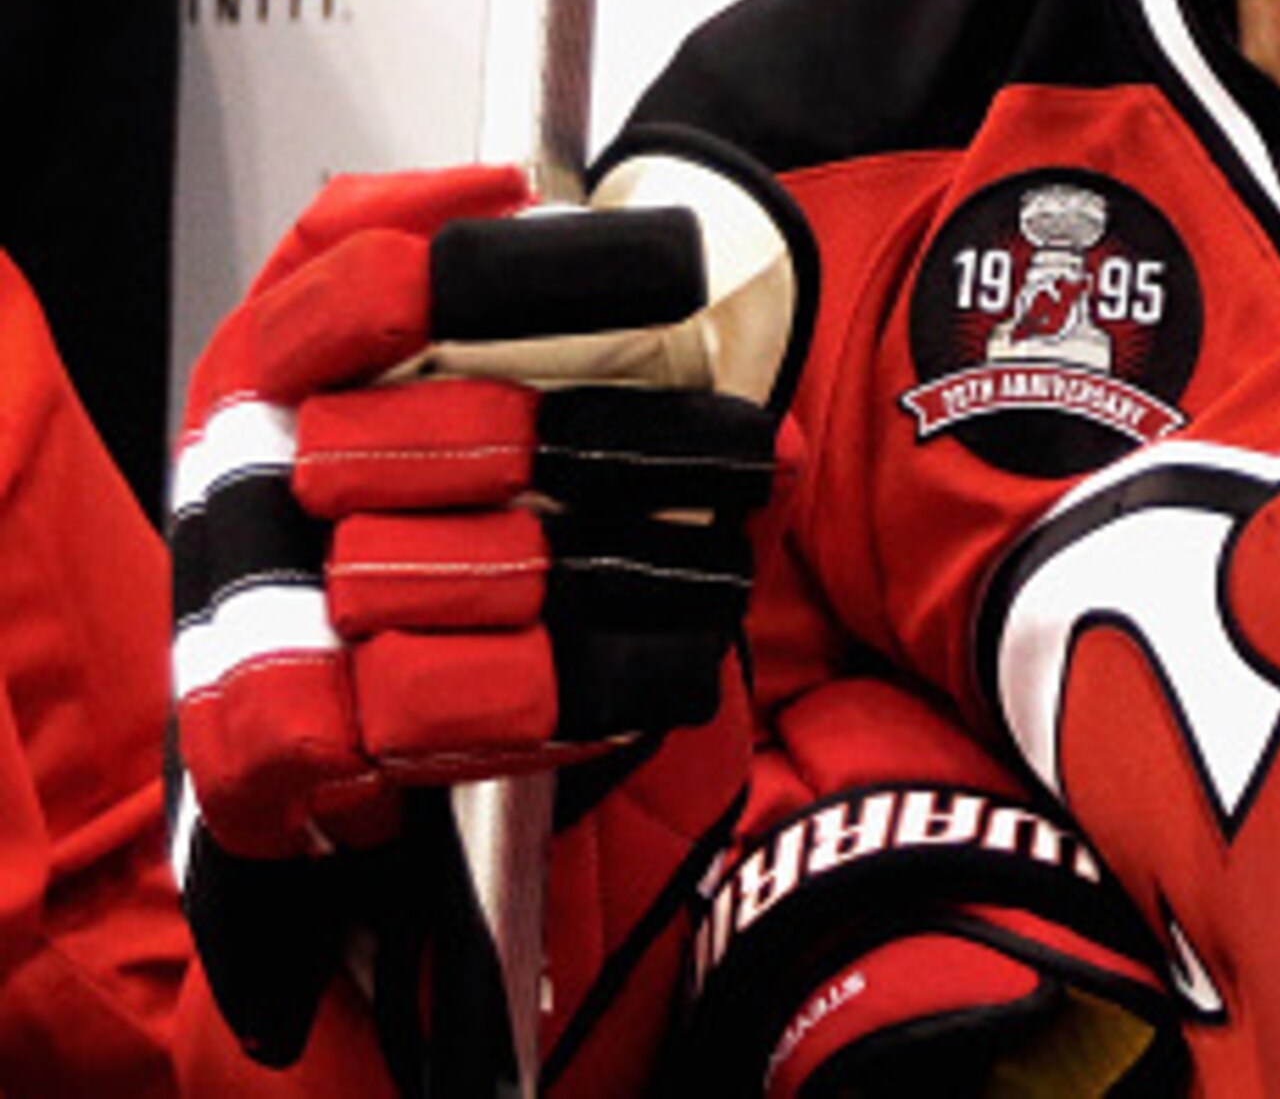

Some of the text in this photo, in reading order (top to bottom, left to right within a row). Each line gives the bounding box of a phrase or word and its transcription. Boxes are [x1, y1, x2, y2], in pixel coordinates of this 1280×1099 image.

[954, 248, 1166, 325] 19 95
[1001, 372, 1148, 426] ANNIVERSARY
